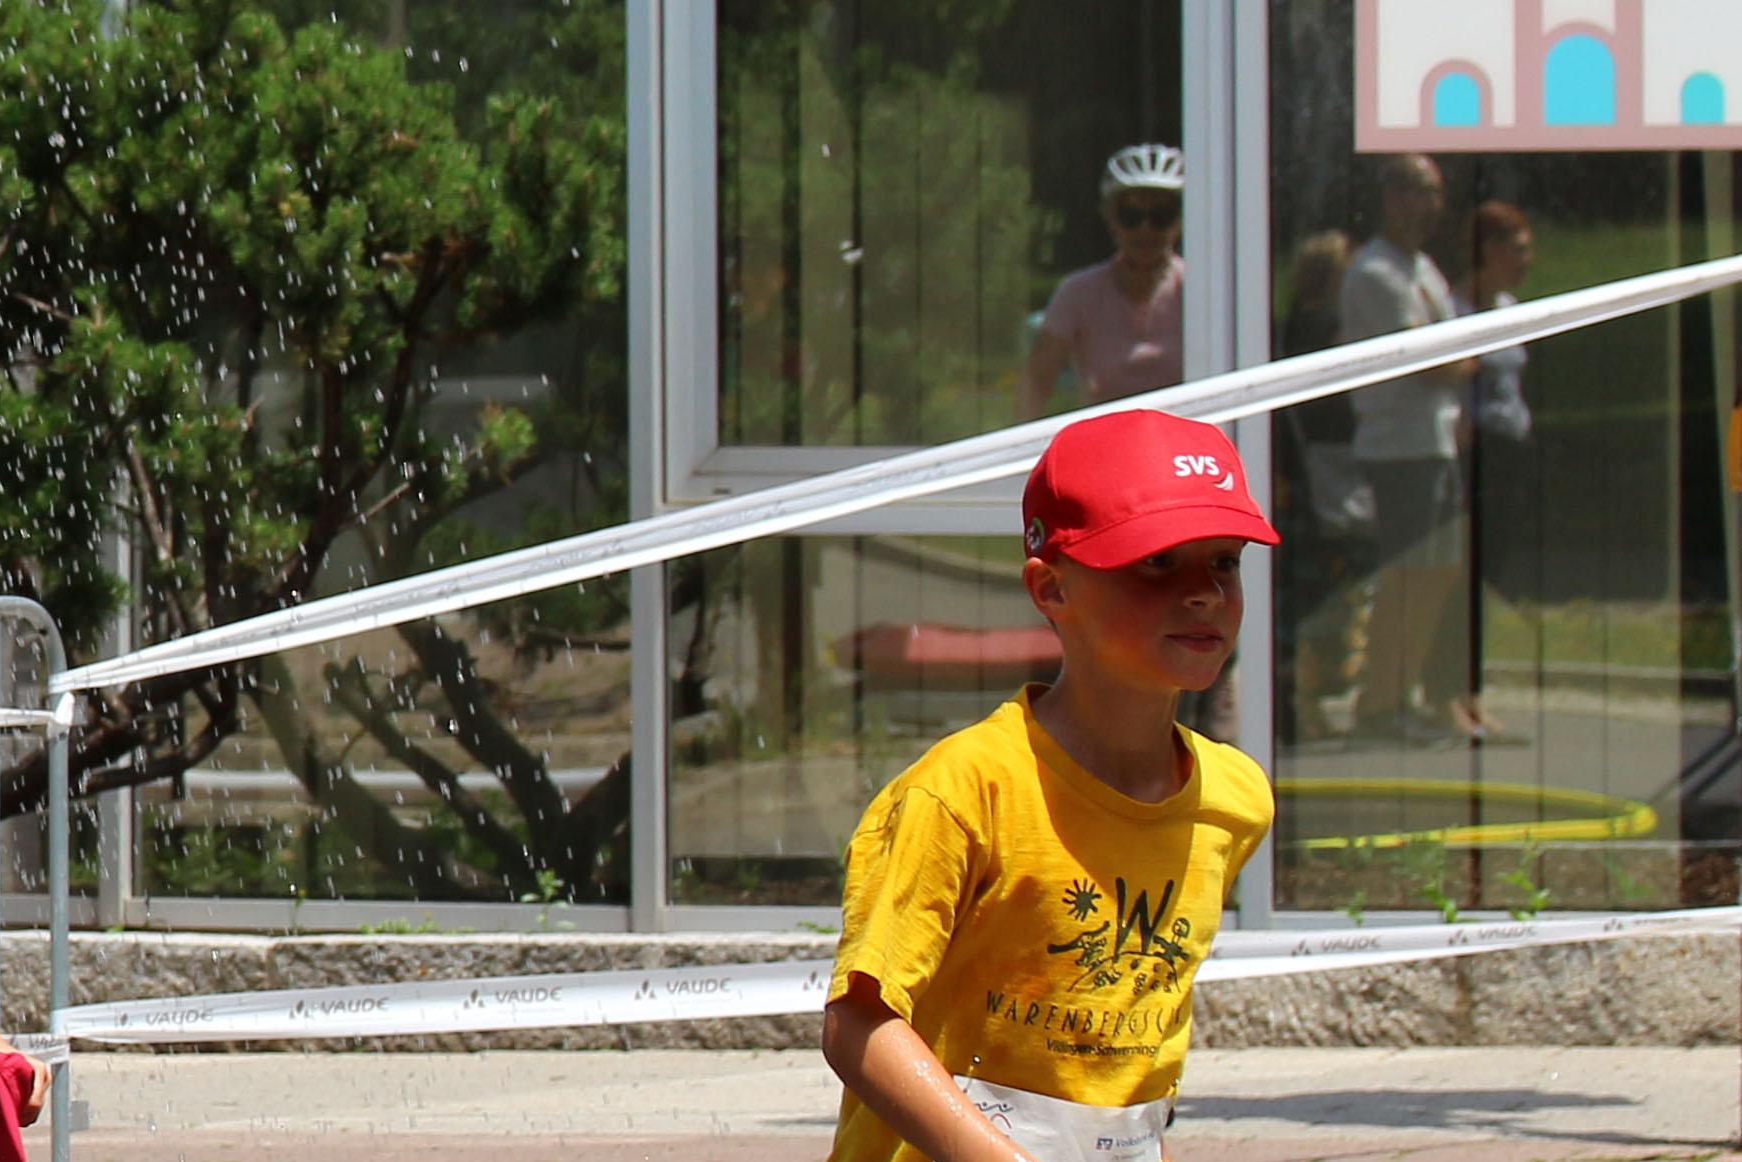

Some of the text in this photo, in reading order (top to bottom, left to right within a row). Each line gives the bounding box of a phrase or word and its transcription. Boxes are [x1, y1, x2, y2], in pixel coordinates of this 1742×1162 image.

[1173, 455, 1220, 477] SVS
[495, 986, 562, 1004] VAUDE
[667, 977, 732, 995] VAUDE
[322, 997, 390, 1014] VAUDE
[145, 1008, 214, 1026] VAUDE
